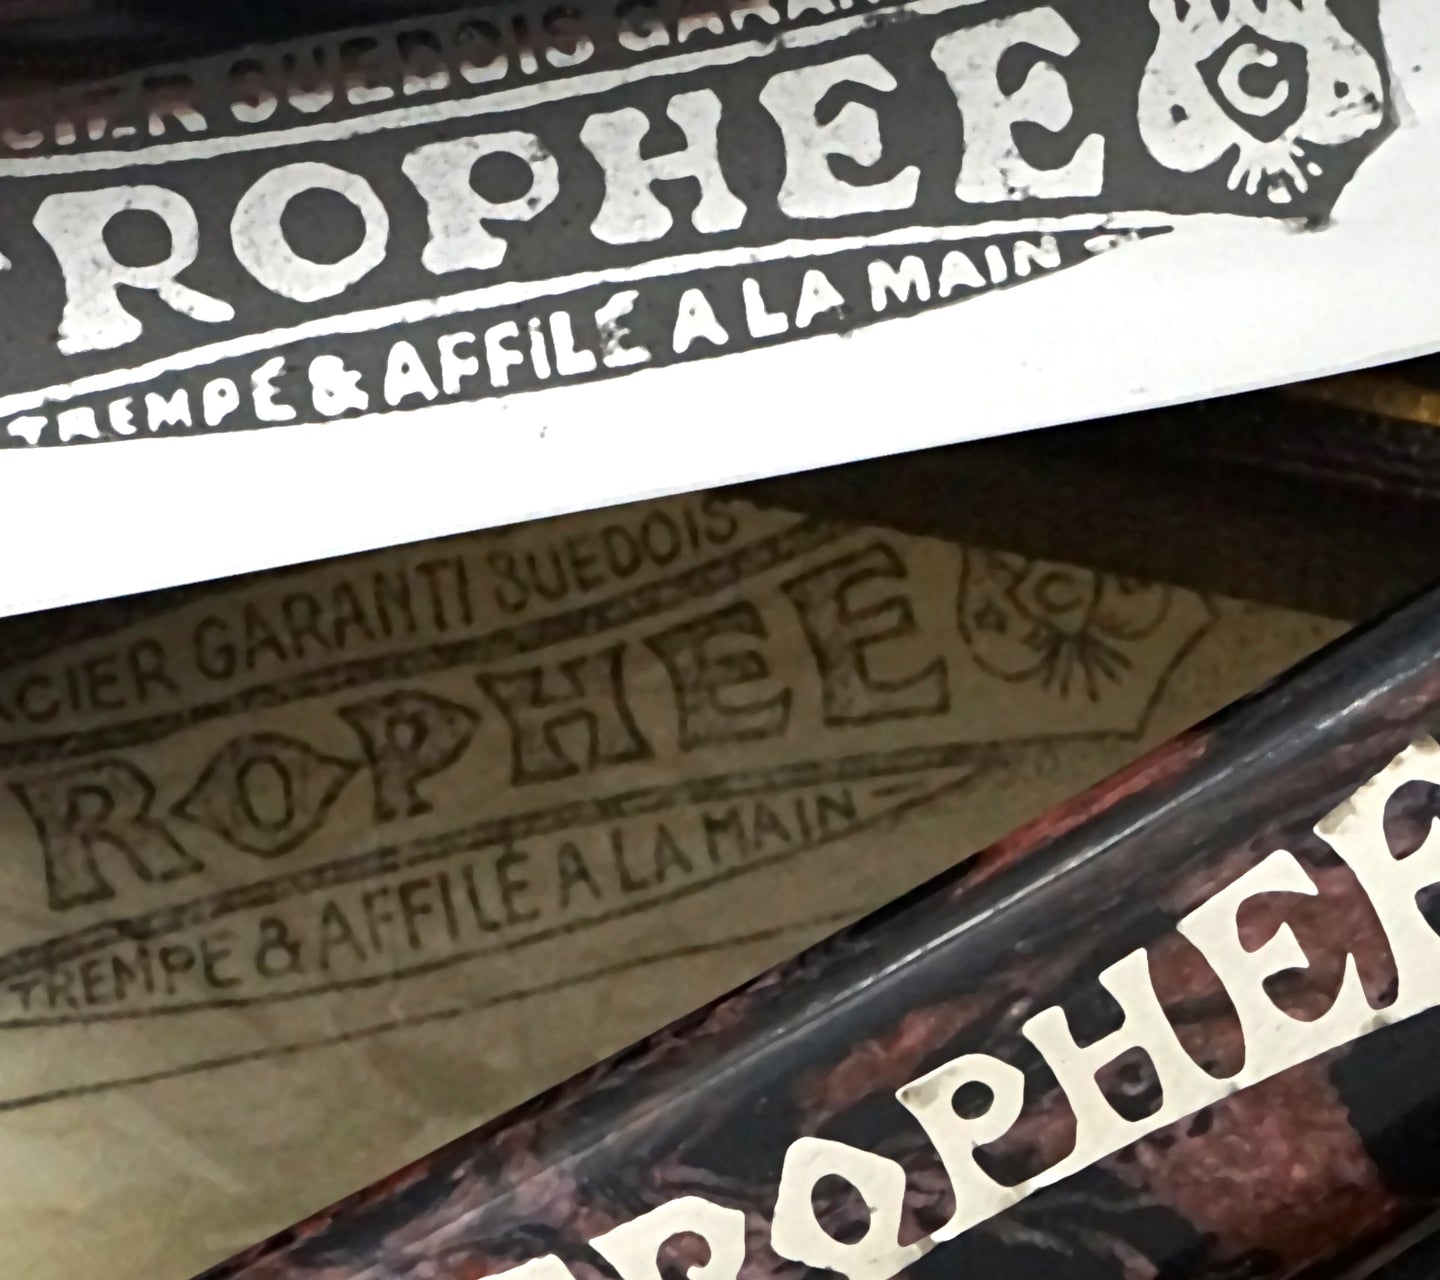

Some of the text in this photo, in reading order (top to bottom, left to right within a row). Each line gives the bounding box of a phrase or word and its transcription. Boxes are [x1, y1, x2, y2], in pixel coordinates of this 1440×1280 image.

[1216, 42, 1289, 116] C
[308, 354, 369, 417] &
[671, 288, 729, 353] A
[742, 269, 845, 339] LA
[867, 235, 1061, 312] MAIN
[193, 553, 471, 683] GARANTI
[490, 497, 743, 617] SUEDOIS
[254, 915, 303, 977] &
[557, 839, 601, 910] A
[610, 825, 694, 894] LA
[701, 786, 858, 864] MAIN
